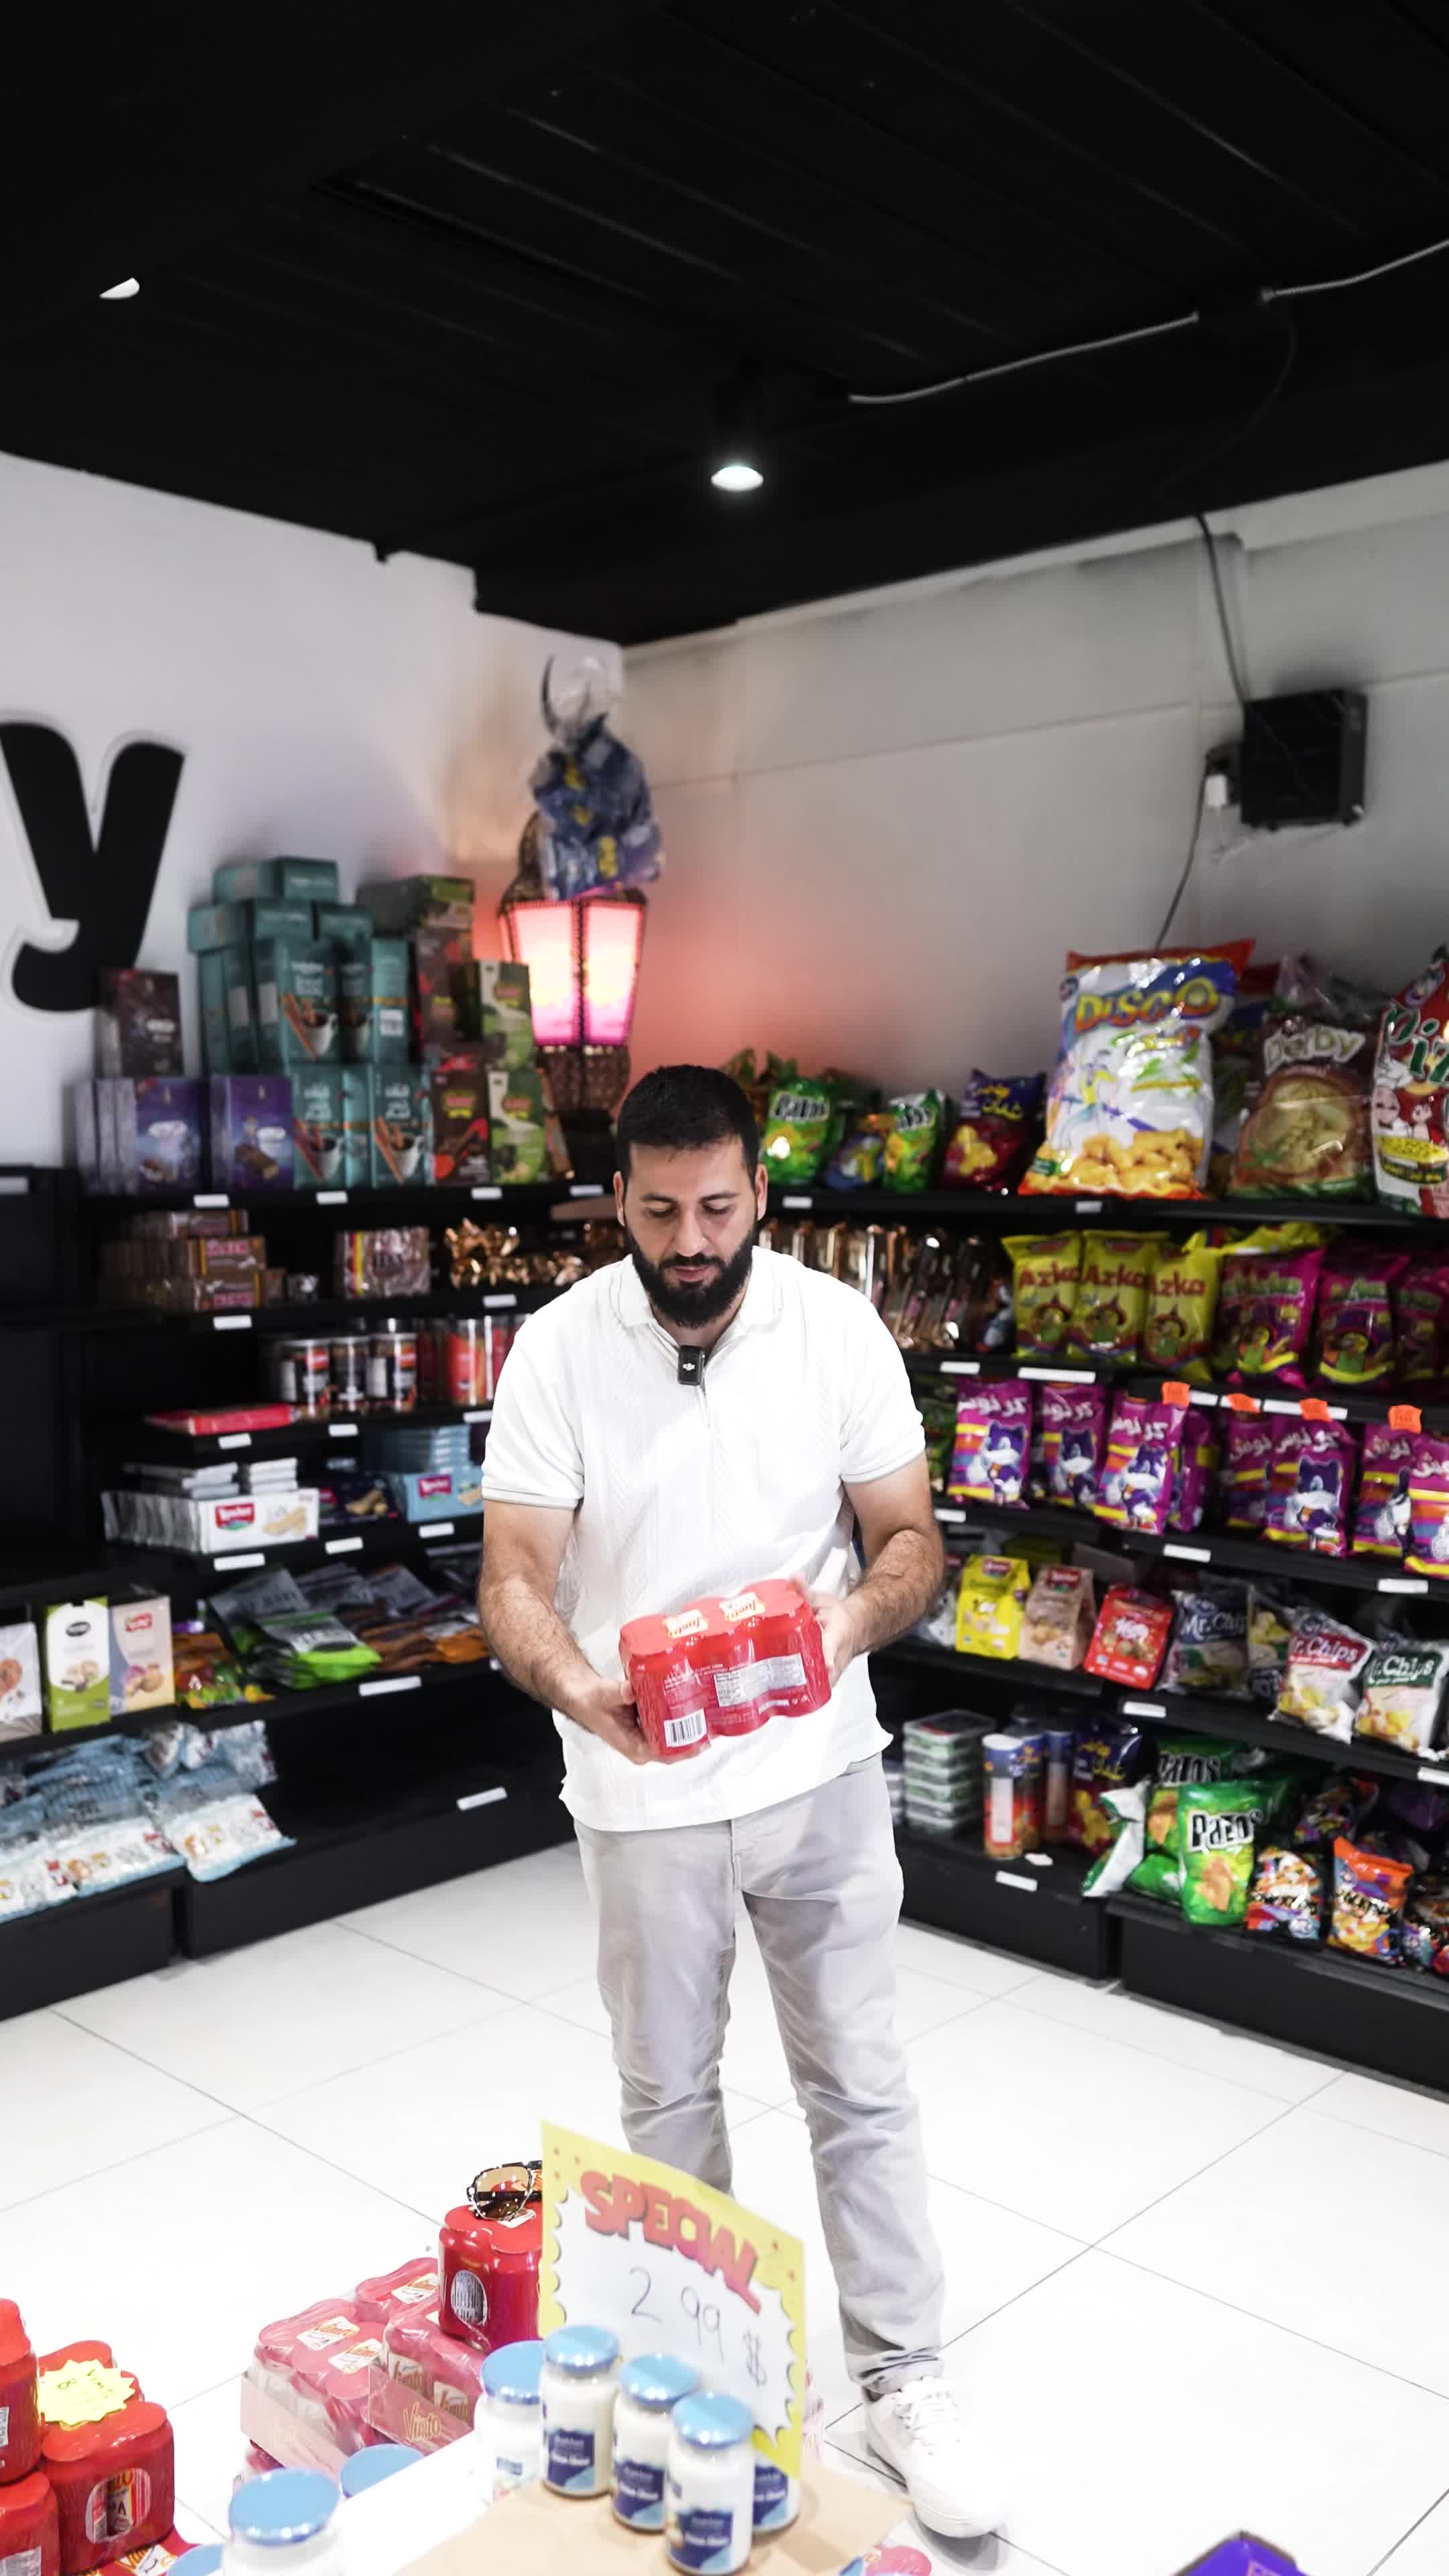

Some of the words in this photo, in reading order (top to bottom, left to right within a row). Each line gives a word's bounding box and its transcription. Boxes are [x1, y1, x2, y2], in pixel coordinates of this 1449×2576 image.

[1074, 978, 1220, 1032] DISCO
[580, 2171, 761, 2316] SPECIAL
[402, 2402, 441, 2443] Vimto
